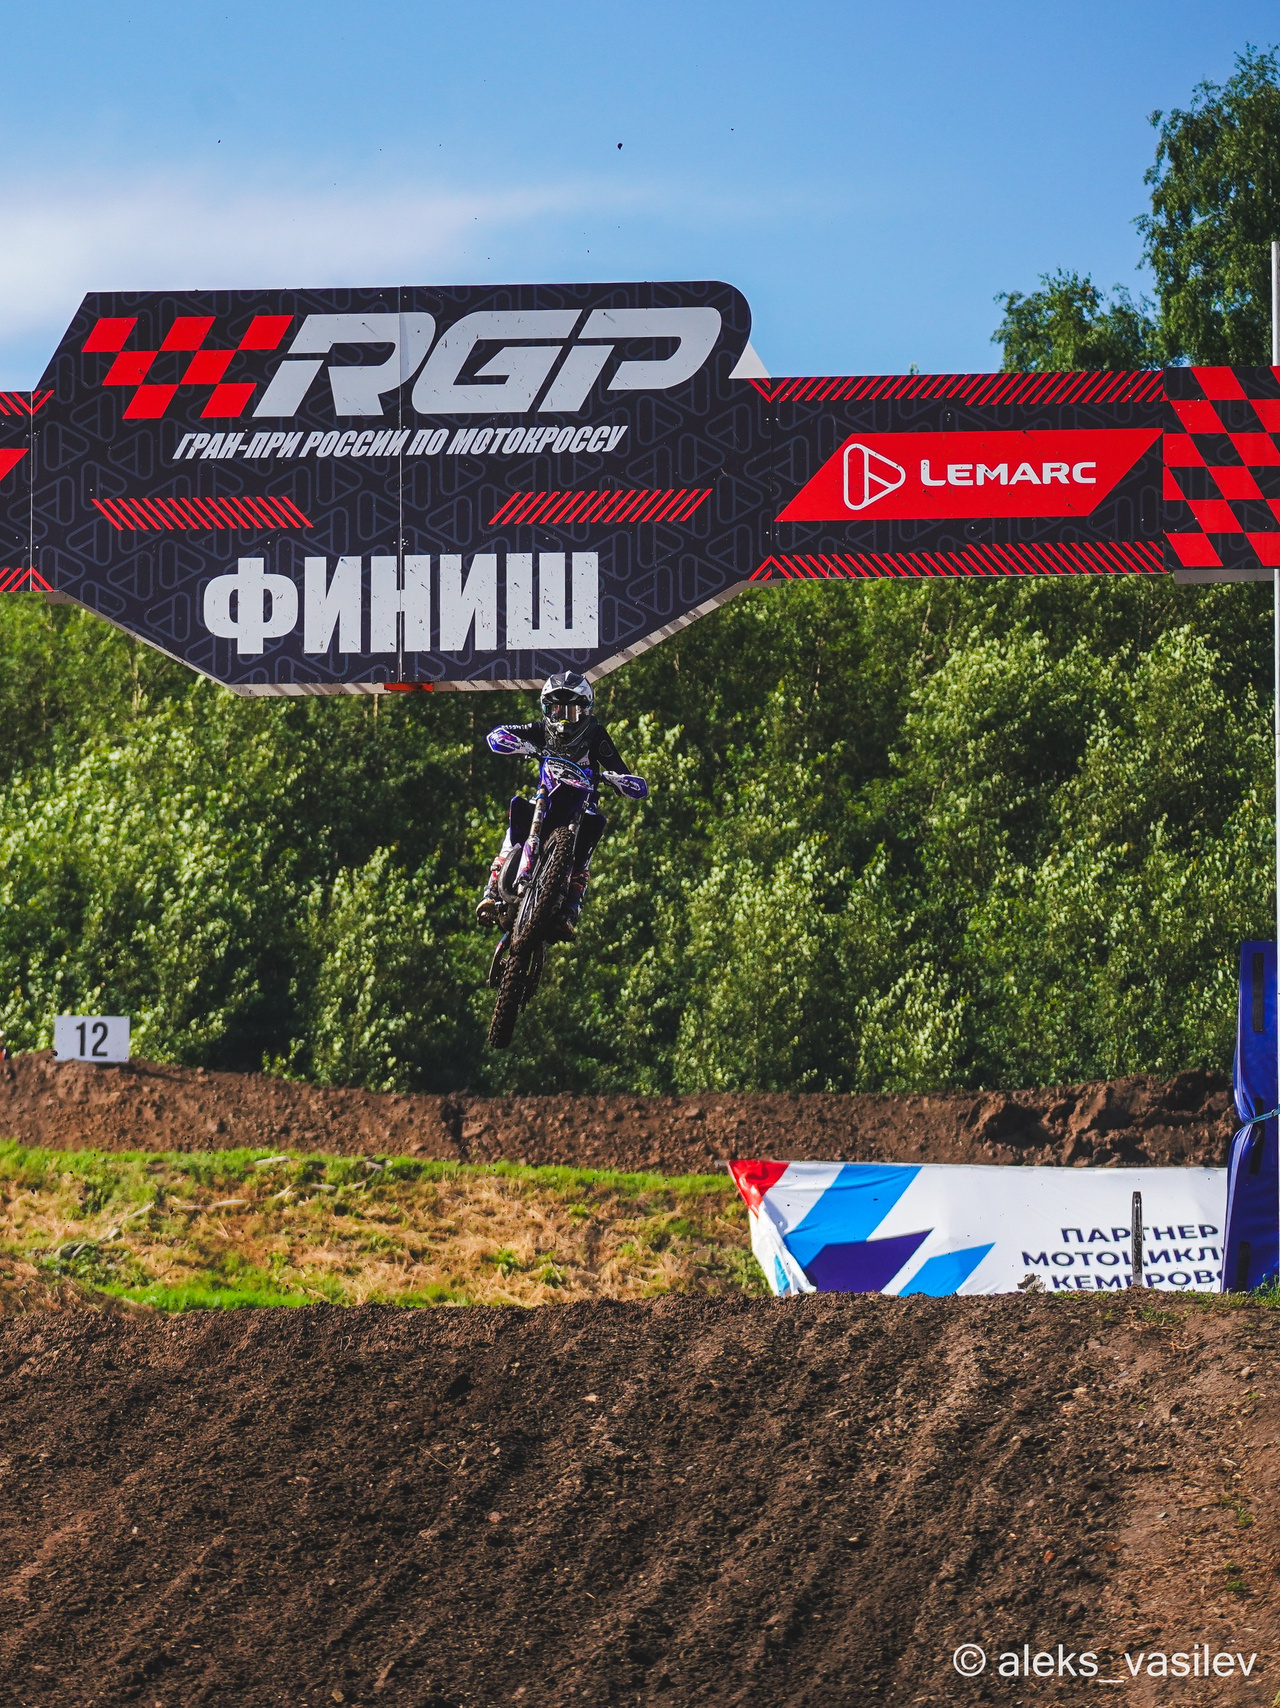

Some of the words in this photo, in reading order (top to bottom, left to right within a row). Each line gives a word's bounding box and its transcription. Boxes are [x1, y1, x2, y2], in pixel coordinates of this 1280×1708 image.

[251, 307, 722, 417] RGP
[172, 432, 304, 459] ГРАН-ПРИ
[298, 430, 411, 457] РОССИИ
[406, 428, 449, 455] ПО
[446, 425, 628, 455] МОТОКРОССУ
[920, 459, 1097, 486] LEMARC
[203, 551, 599, 654] ФИНИШ
[75, 1021, 108, 1057] 12
[1021, 1246, 1224, 1267] МОТОЦИКЛ
[1051, 1269, 1223, 1290] КЕМРОВ
